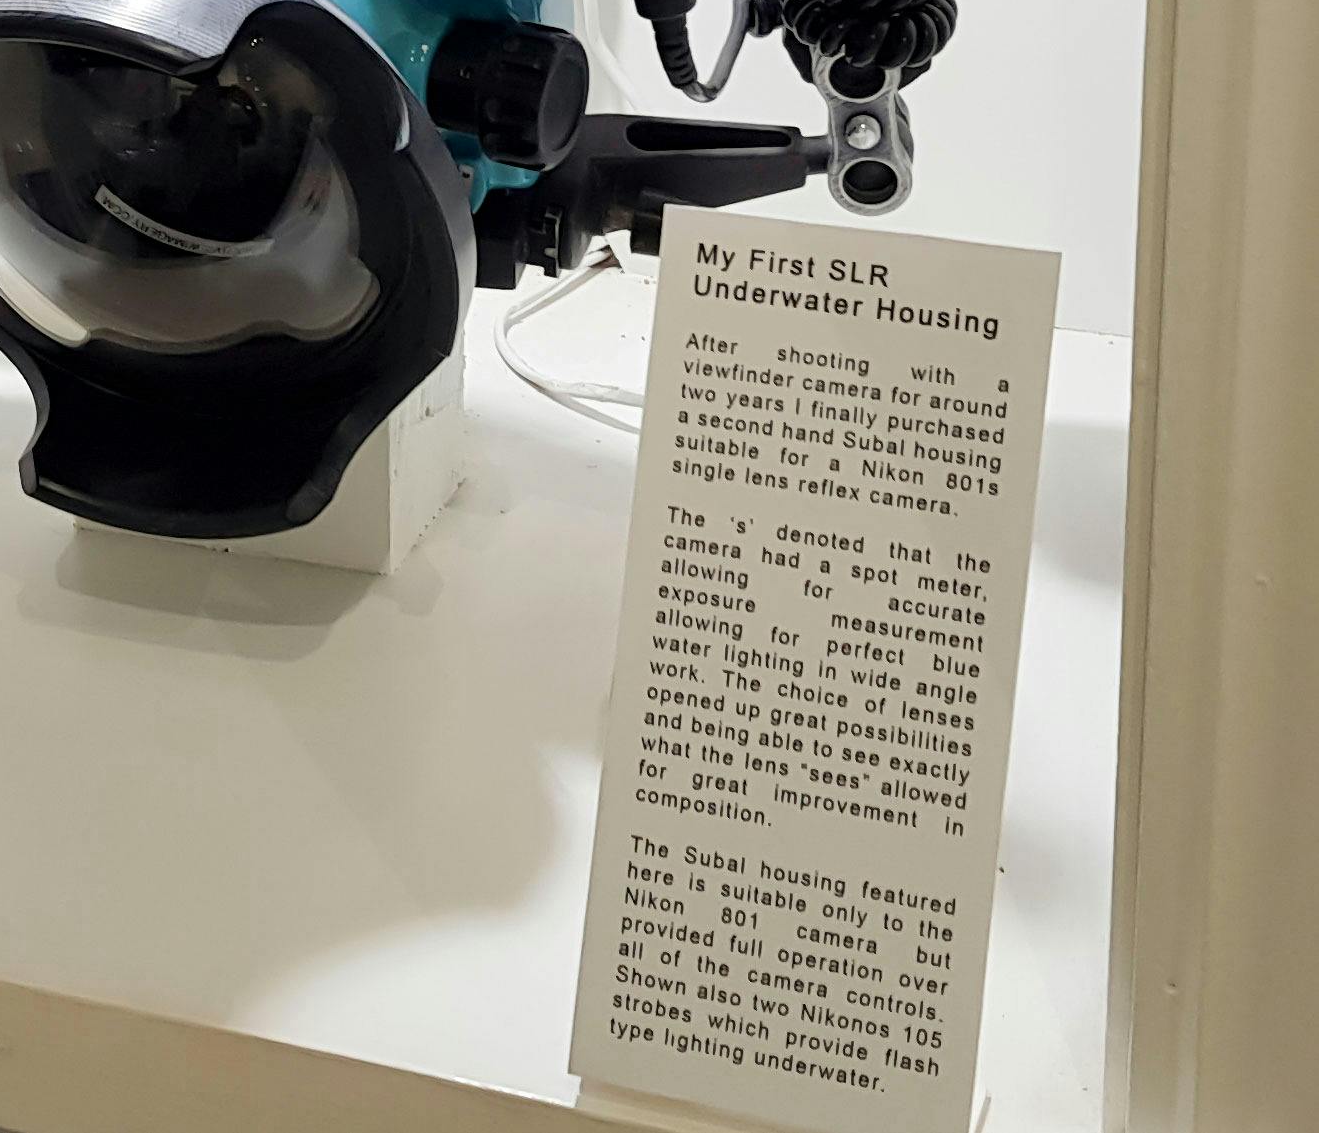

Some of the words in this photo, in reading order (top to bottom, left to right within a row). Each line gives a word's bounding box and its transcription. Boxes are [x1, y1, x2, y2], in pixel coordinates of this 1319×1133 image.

[696, 242, 736, 273] My
[749, 248, 816, 279] First
[828, 258, 889, 289] SLR
[693, 273, 864, 317] Underwater
[876, 297, 999, 341] Housing
[683, 358, 795, 388] viewfinder
[802, 377, 881, 401] camera
[891, 386, 922, 407] for
[929, 395, 1008, 419] around
[685, 332, 739, 355] After
[777, 345, 870, 378] shooting
[910, 365, 955, 386] with
[997, 379, 1010, 394] a
[677, 410, 689, 425] a
[697, 413, 774, 437] second
[781, 421, 835, 446] hand
[842, 430, 905, 457] Subal
[913, 440, 1002, 475] housing
[681, 383, 716, 403] two
[726, 392, 784, 413] years
[811, 400, 878, 430] finally
[887, 415, 1005, 445] purchased
[672, 457, 736, 483] single
[744, 466, 789, 490] lens
[798, 478, 860, 502] reflex
[869, 490, 958, 517] camera.
[674, 434, 760, 460] suitable
[780, 446, 809, 467] for
[828, 458, 840, 473] a
[861, 459, 924, 486] Nikon
[945, 472, 999, 496] 801s
[663, 534, 742, 560] camera
[761, 546, 801, 570] had
[819, 560, 831, 575] a
[851, 564, 898, 586] spot
[667, 505, 706, 528] The
[776, 523, 865, 554] denoted
[889, 541, 931, 565] that
[957, 552, 991, 574] the
[658, 585, 756, 614] exposure
[831, 613, 984, 653] measurement
[661, 557, 749, 591] allowing
[803, 579, 834, 600] for
[887, 597, 986, 626] accurate
[652, 635, 712, 658] water
[724, 643, 804, 678] lighting
[818, 659, 837, 681] in
[850, 668, 901, 691] wide
[915, 681, 977, 706] angle
[655, 608, 743, 642] allowing
[771, 626, 800, 647] for
[826, 639, 904, 666] perfect
[933, 653, 980, 678] blue
[646, 686, 725, 712] opened
[735, 701, 761, 723] up
[770, 707, 827, 732] great
[836, 720, 972, 757] possibilities
[649, 661, 705, 684] work.
[721, 668, 762, 693] The
[777, 681, 849, 708] choice
[864, 697, 887, 715] of
[901, 700, 974, 731] lenses
[641, 735, 691, 759] what
[701, 744, 734, 766] the
[744, 752, 789, 777] lens
[880, 779, 967, 811] allowed
[643, 711, 683, 731] and
[691, 715, 749, 747] being
[758, 730, 804, 753] able
[813, 739, 833, 758] to
[841, 747, 880, 767] see
[889, 756, 970, 787] exactly
[635, 788, 772, 827] composition.
[639, 758, 667, 780] for
[691, 772, 748, 796] great
[774, 783, 918, 829] improvement
[945, 816, 964, 837] in
[627, 860, 674, 886] here
[688, 872, 706, 893] is
[720, 883, 807, 913] suitable
[822, 903, 868, 929] only
[883, 912, 904, 932] to
[919, 919, 953, 942] the
[630, 834, 669, 859] The
[683, 845, 746, 875] Subal
[760, 859, 846, 899] housing
[862, 880, 956, 916] featured
[620, 916, 715, 948] provided
[729, 934, 763, 959] full
[777, 948, 883, 983] operation
[898, 973, 949, 996] over
[624, 886, 685, 916] Nikon
[721, 906, 758, 930] 801
[796, 925, 878, 955] camera
[916, 944, 951, 970] but
[615, 963, 686, 996] Shown
[696, 984, 742, 1007] also
[752, 994, 790, 1017] two
[800, 1003, 890, 1039] Nikonos
[904, 1026, 942, 1050] 105
[618, 940, 644, 961] all
[660, 949, 682, 968] of
[697, 955, 730, 978] the
[747, 969, 828, 999] camera
[846, 990, 944, 1023] controls.
[610, 1017, 655, 1043] type
[664, 1027, 744, 1066] lighting
[754, 1051, 885, 1093] underwater.
[612, 993, 692, 1024] strobes
[707, 1013, 770, 1041] which
[785, 1031, 868, 1061] provide
[885, 1048, 939, 1077] flash
